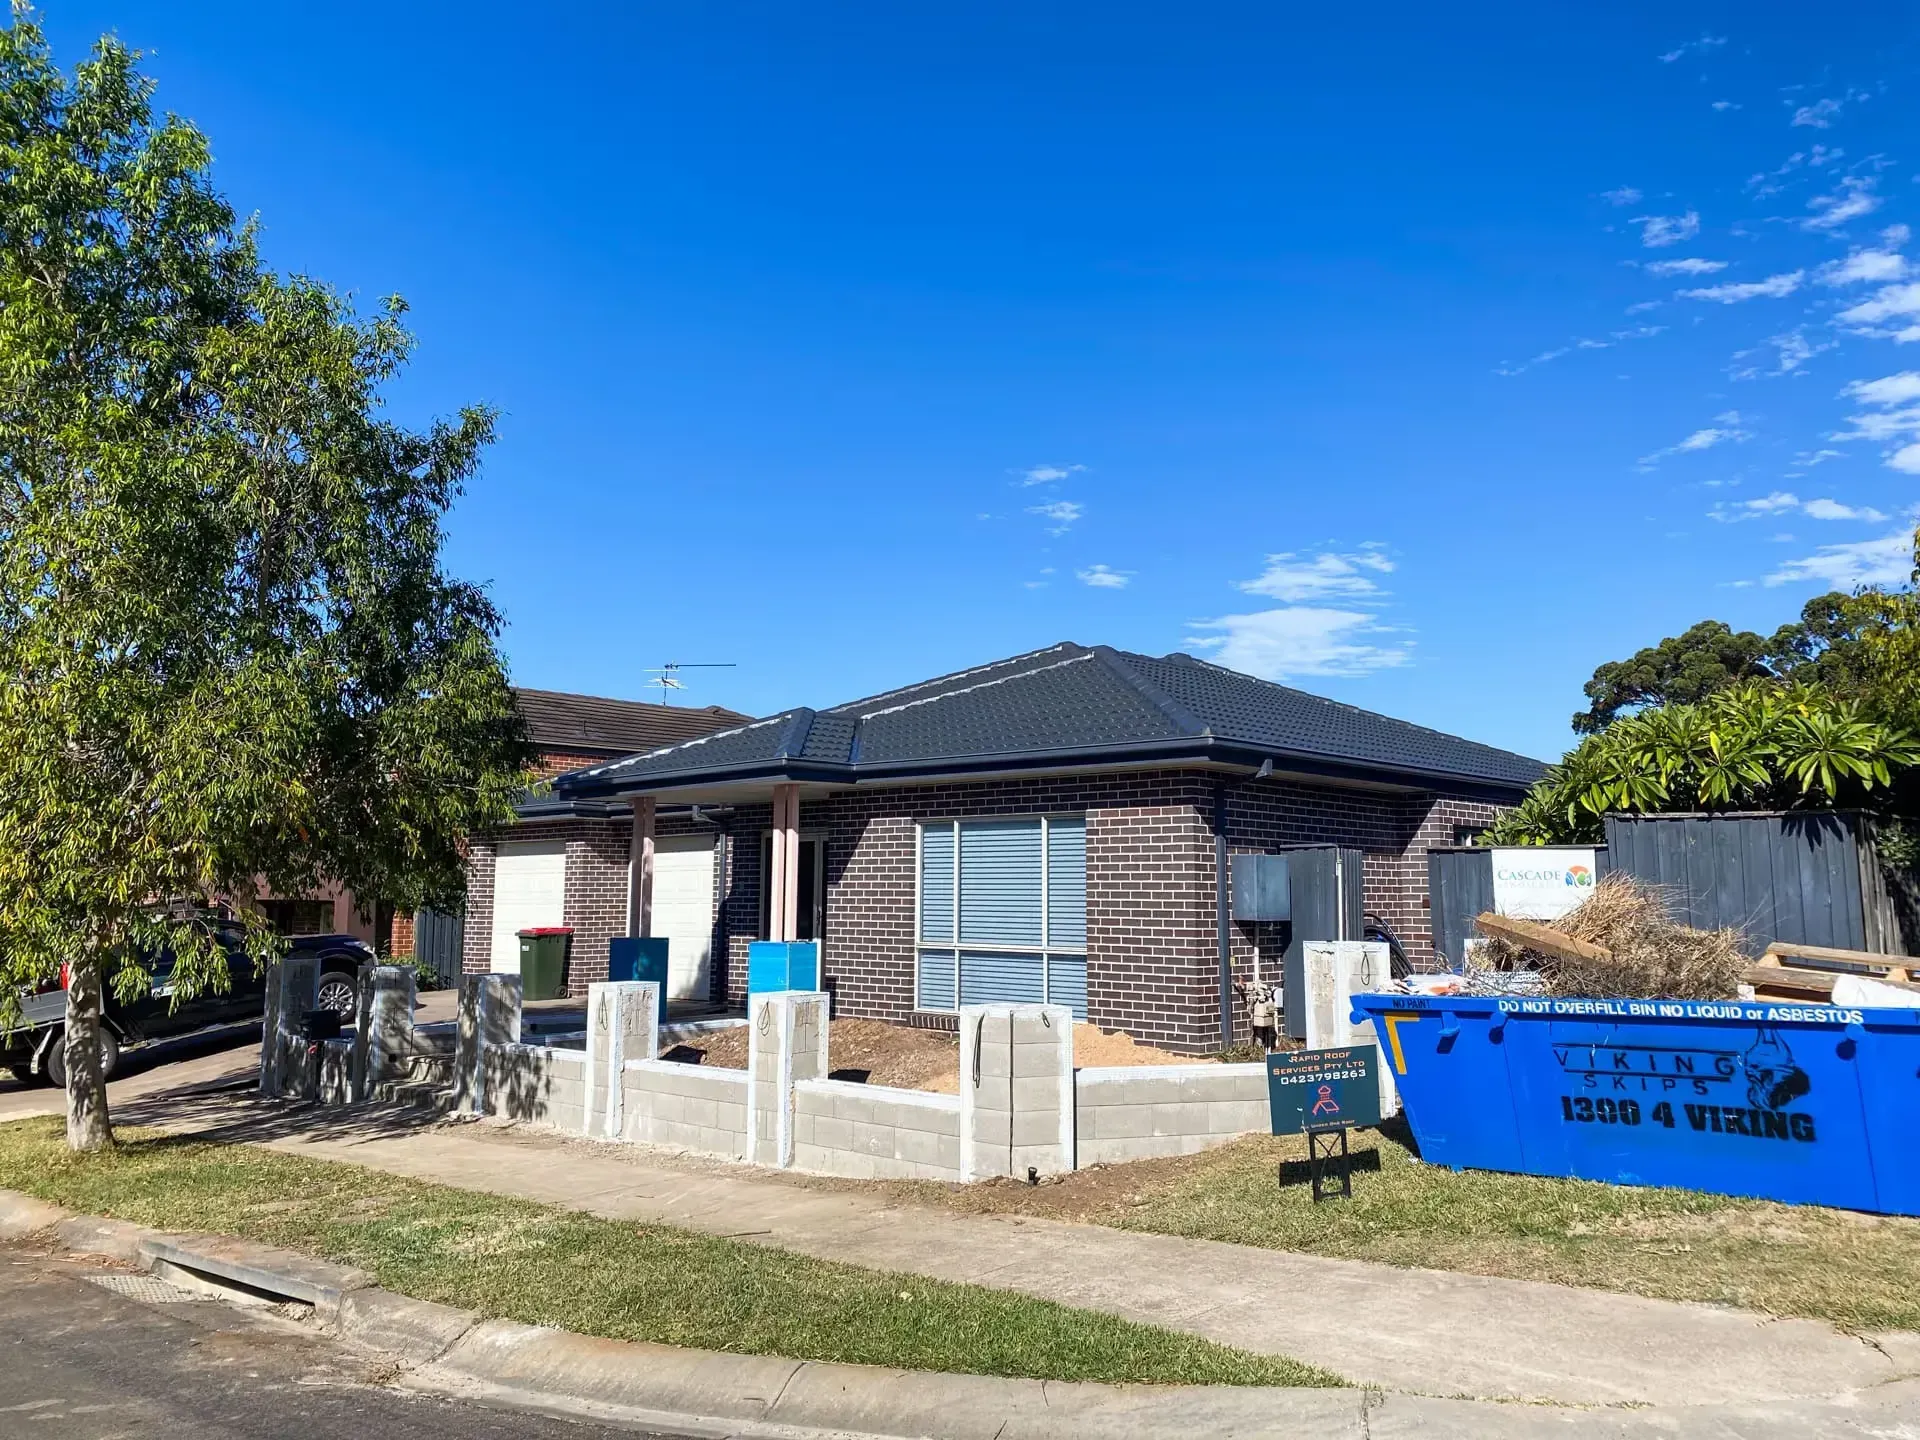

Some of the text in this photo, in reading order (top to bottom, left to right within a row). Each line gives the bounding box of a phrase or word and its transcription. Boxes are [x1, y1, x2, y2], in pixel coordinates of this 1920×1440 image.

[1497, 869, 1561, 881] CASCADE
[1392, 998, 1405, 1009] NO
[1498, 1000, 1864, 1024] DO NOT OVERFILL BIN NO LIQUID or ASBESTOS
[1290, 1052, 1351, 1062] RAPID ROOF
[1553, 1048, 1736, 1077] VIKING
[1273, 1065, 1320, 1075] SERVICES
[1346, 1060, 1365, 1068] LTD
[1280, 1069, 1366, 1085] 0423798263
[1584, 1073, 1709, 1096] SKIPS
[1560, 1096, 1817, 1143] 1300 4 VIKING
